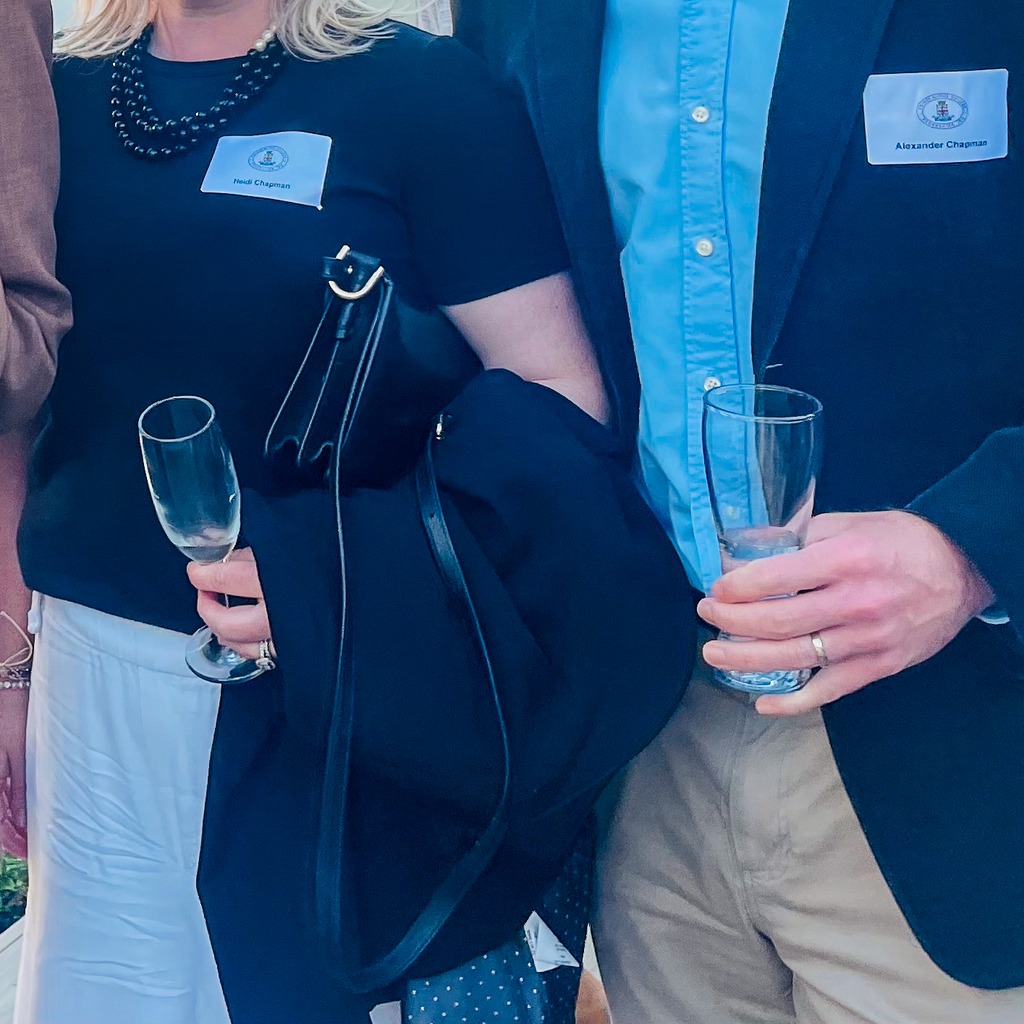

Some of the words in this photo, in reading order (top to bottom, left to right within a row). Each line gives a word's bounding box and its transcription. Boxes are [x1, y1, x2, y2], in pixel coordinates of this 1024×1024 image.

[895, 141, 944, 150] Alexander
[946, 140, 988, 149] Chapman
[233, 178, 253, 186] Heidi
[254, 179, 291, 189] Chapman
